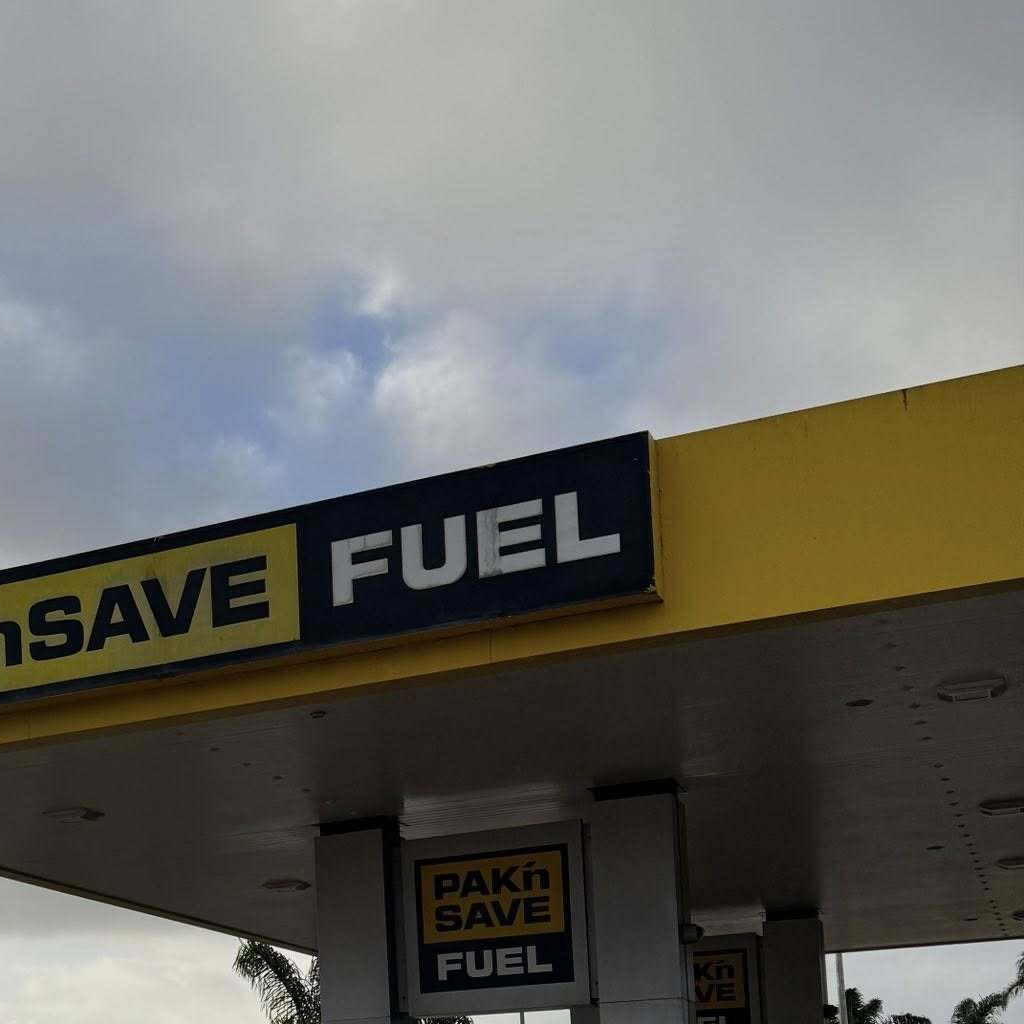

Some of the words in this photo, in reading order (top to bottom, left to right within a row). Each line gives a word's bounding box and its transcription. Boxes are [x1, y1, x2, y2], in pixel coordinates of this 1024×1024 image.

[331, 490, 622, 607] FUEL
[435, 896, 551, 932] SAVE
[437, 946, 553, 981] FUEL
[695, 982, 736, 1003] VE
